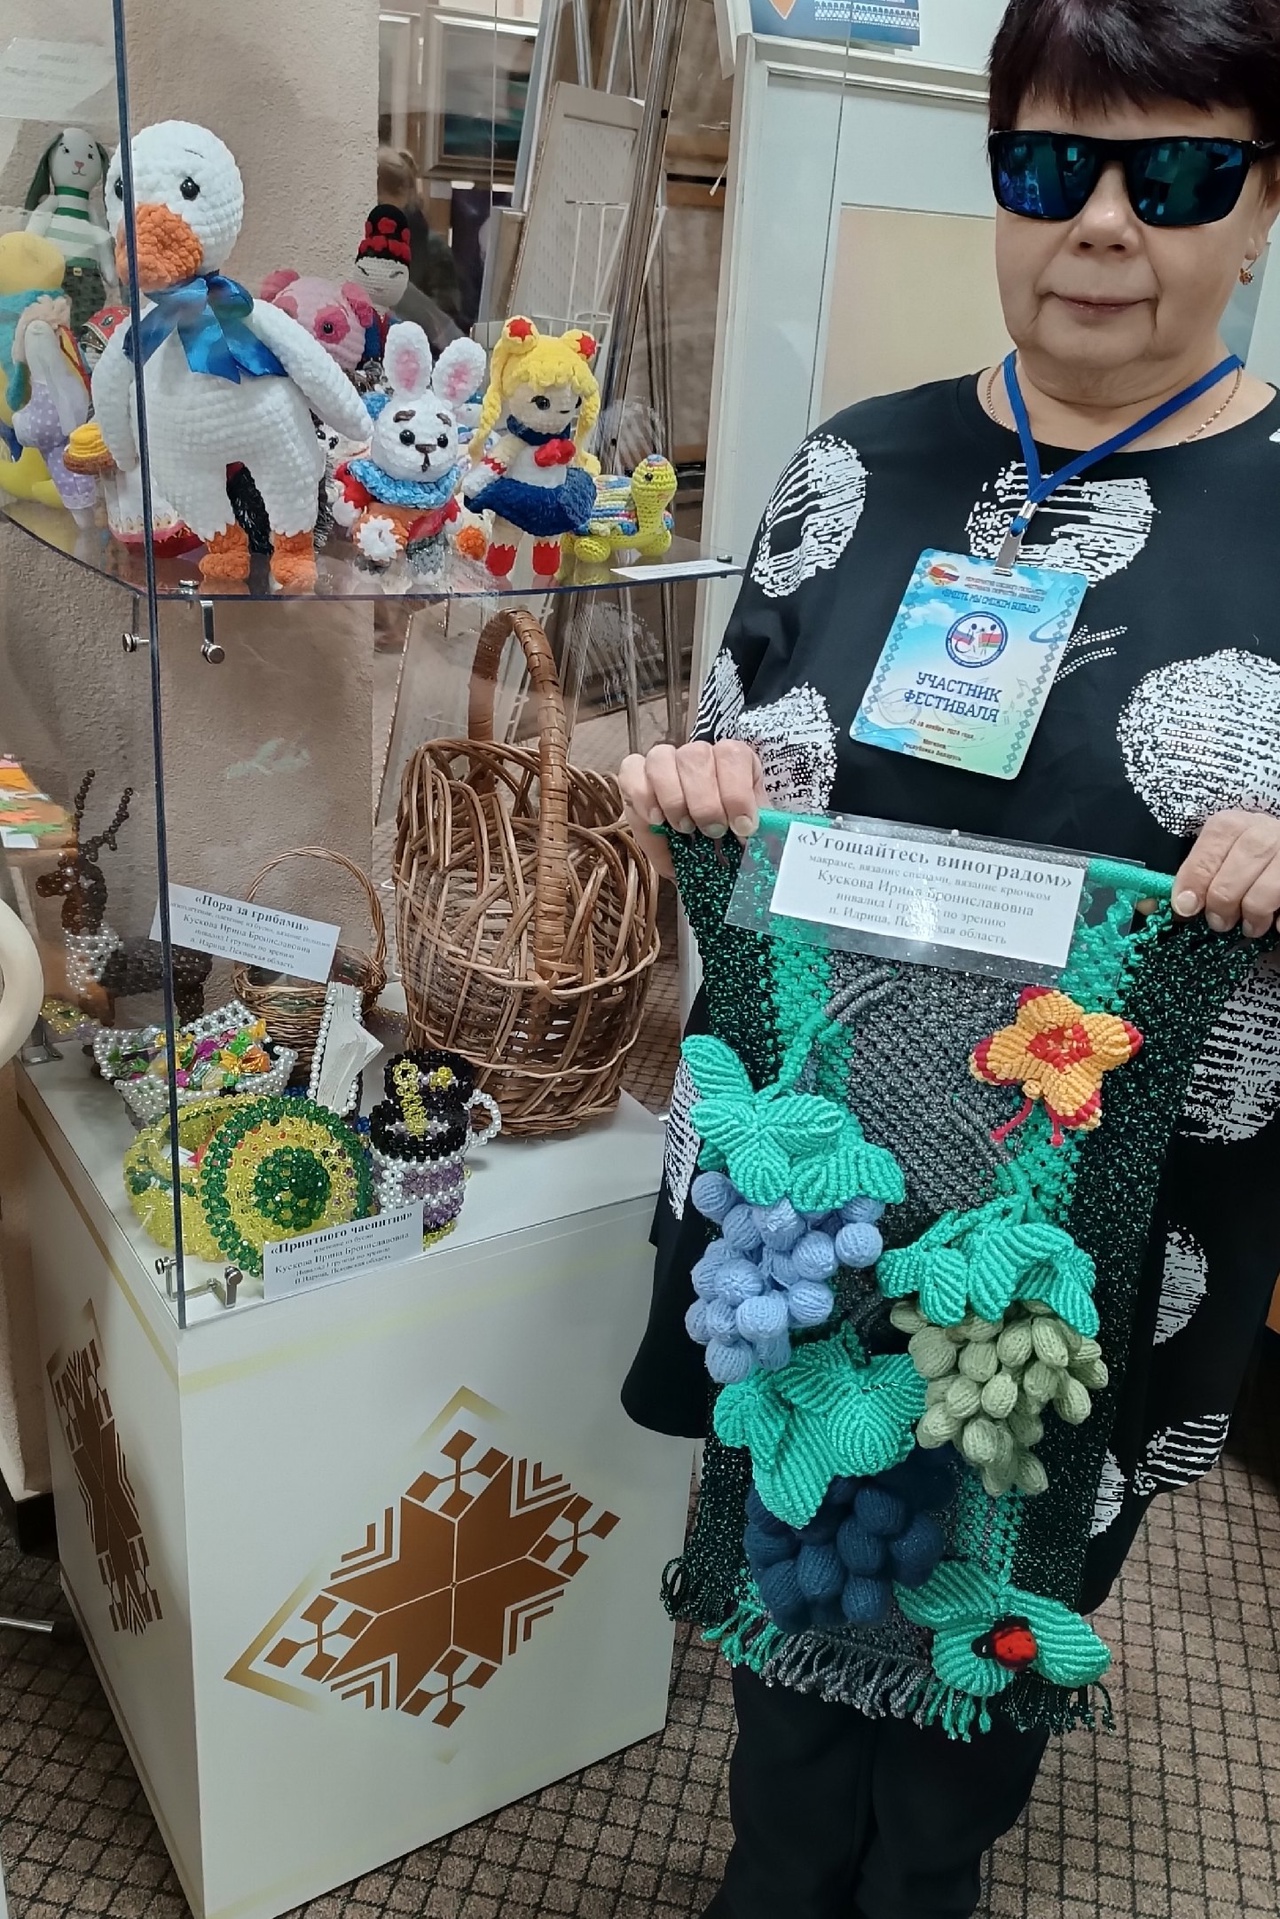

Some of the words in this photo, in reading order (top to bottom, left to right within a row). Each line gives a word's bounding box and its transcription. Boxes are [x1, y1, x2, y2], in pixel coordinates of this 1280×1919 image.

[903, 689, 1000, 723] ФЕСТИВАЛЯ
[915, 672, 1003, 703] УЧАСТНИК
[795, 827, 932, 866] «Угощайтесь
[934, 854, 1074, 892] виноградом»
[807, 854, 857, 871] макраме,
[858, 863, 900, 876] вязание
[953, 878, 998, 892] вязание
[999, 885, 1052, 903] крючком
[816, 868, 876, 892] Кускова
[877, 878, 924, 900] Ирина
[925, 886, 1036, 918] Брониславовна
[835, 891, 886, 909] инвалид
[942, 909, 958, 920] по
[960, 912, 1007, 931] зрению
[183, 913, 218, 931] Кускова
[219, 922, 247, 938] Ирина
[194, 892, 233, 914] «Пора
[236, 905, 248, 916] за
[250, 907, 311, 935] грибами»
[958, 925, 1008, 945] область
[270, 1226, 347, 1258] «Приятного
[351, 1211, 412, 1234] чаепития»
[275, 1256, 312, 1275] Кускова
[315, 1248, 342, 1264] Ирина
